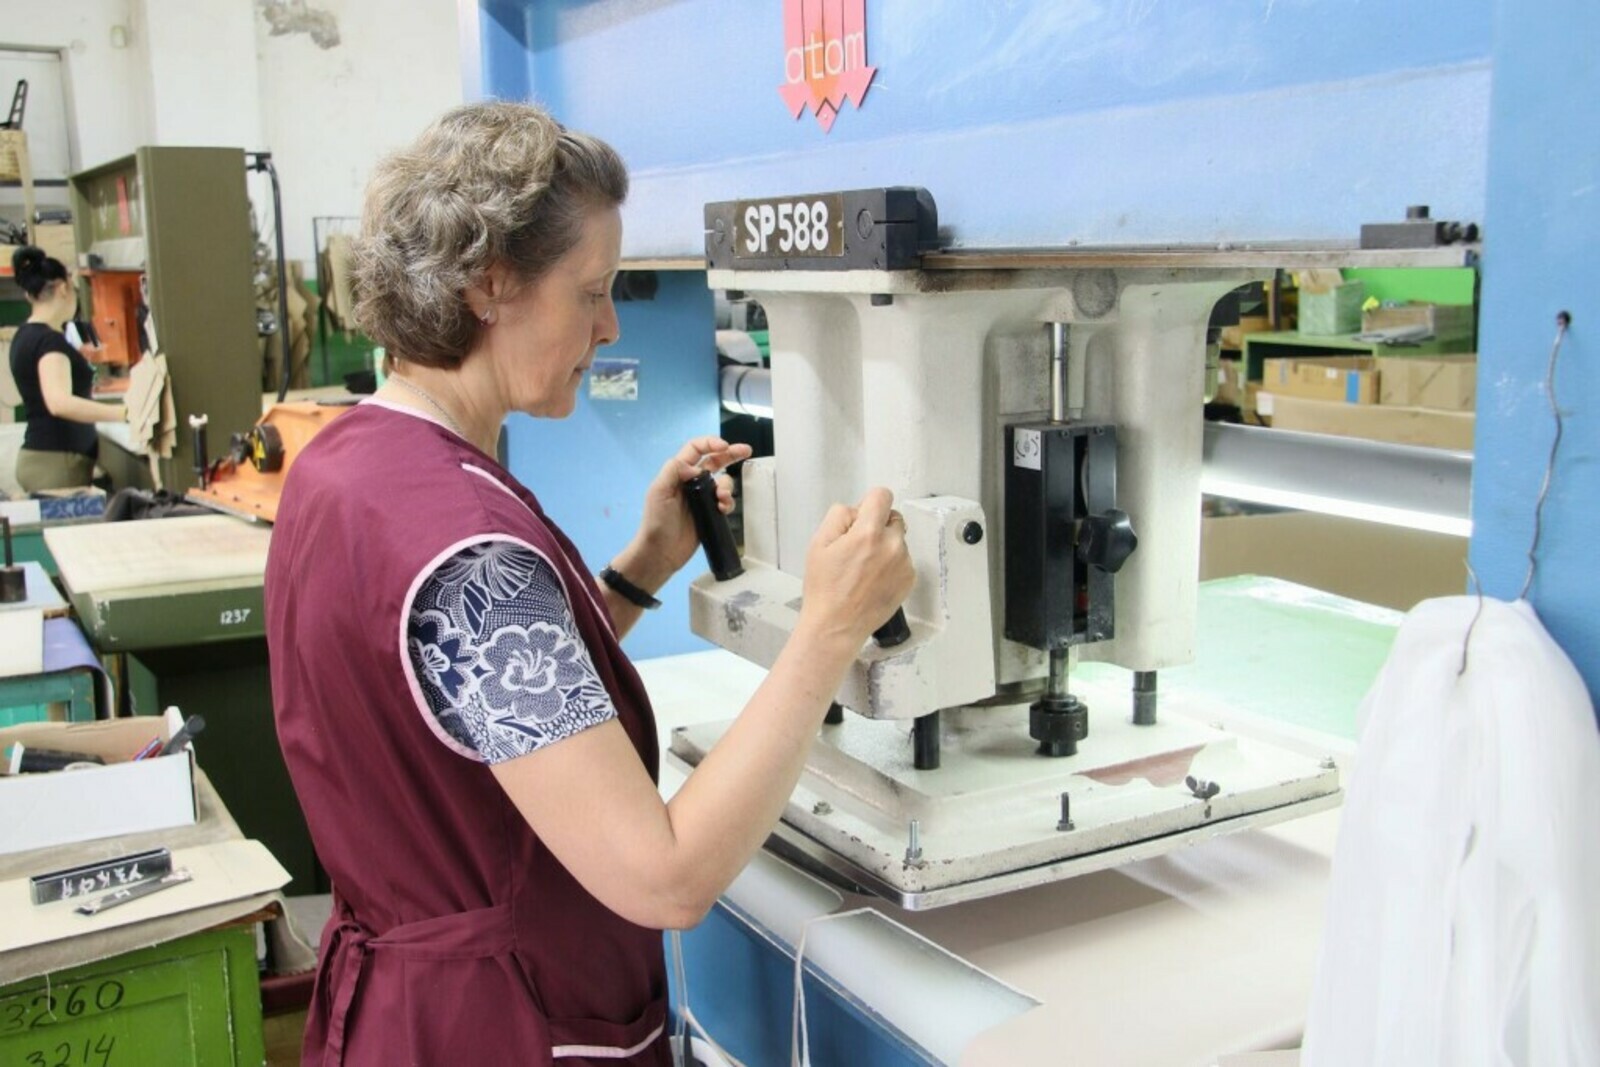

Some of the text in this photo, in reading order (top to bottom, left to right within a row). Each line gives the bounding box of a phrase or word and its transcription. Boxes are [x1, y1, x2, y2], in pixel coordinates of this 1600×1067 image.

[785, 32, 864, 84] atom
[4, 981, 124, 1031] 3260
[26, 1034, 115, 1067] 3214
